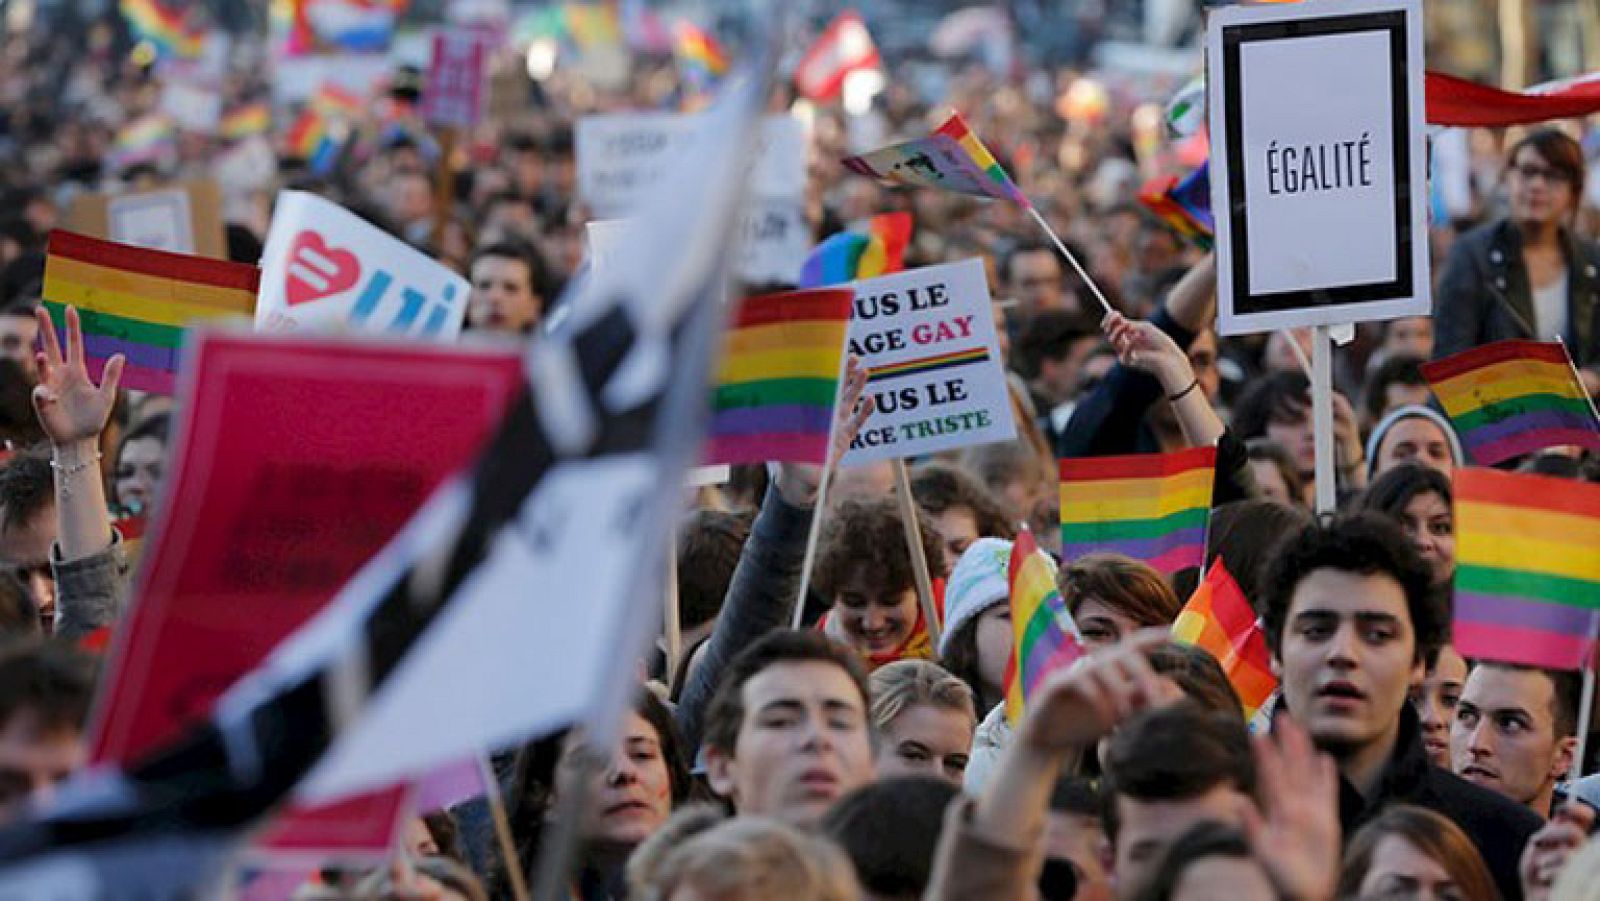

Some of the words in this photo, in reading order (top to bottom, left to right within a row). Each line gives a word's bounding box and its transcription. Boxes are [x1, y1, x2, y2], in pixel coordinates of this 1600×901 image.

[1267, 132, 1371, 195] ÉGALITÉ
[851, 293, 900, 320] US
[906, 283, 949, 312] LE
[911, 315, 974, 346] GAY
[925, 379, 968, 406] LE
[900, 409, 992, 441] TRISTE
